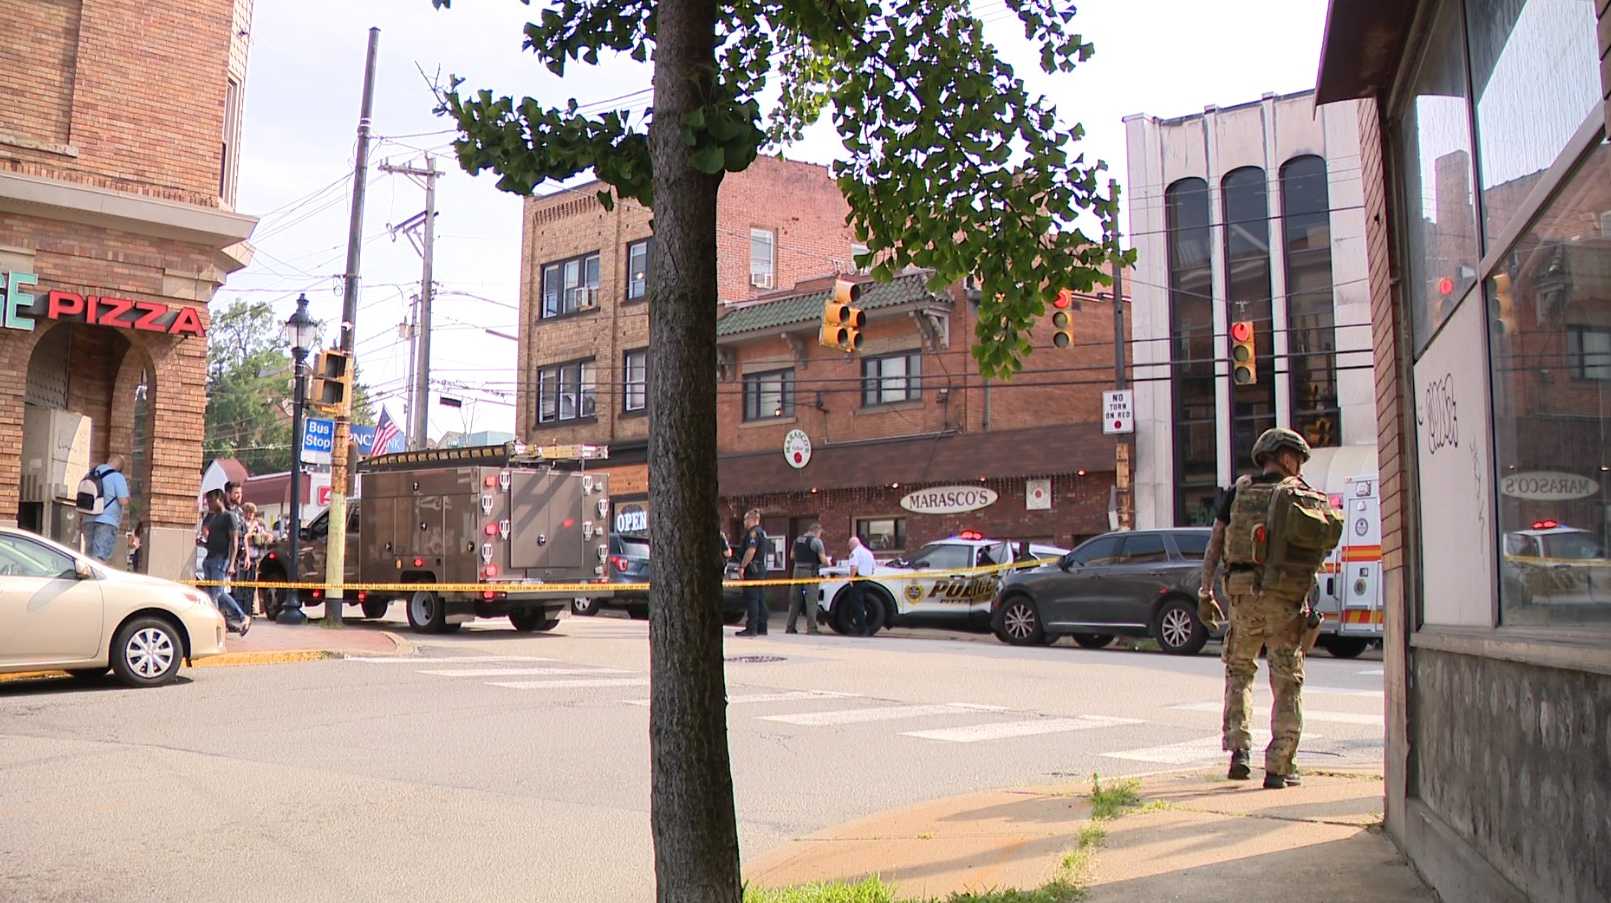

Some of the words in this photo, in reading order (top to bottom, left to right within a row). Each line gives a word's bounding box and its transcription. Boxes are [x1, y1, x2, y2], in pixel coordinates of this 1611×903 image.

[47, 289, 207, 337] PIZZA
[1112, 393, 1124, 403] NO
[308, 421, 329, 434] Bus
[305, 434, 331, 449] Stop
[909, 490, 988, 509] MARASCO'S
[617, 511, 648, 532] OPEN
